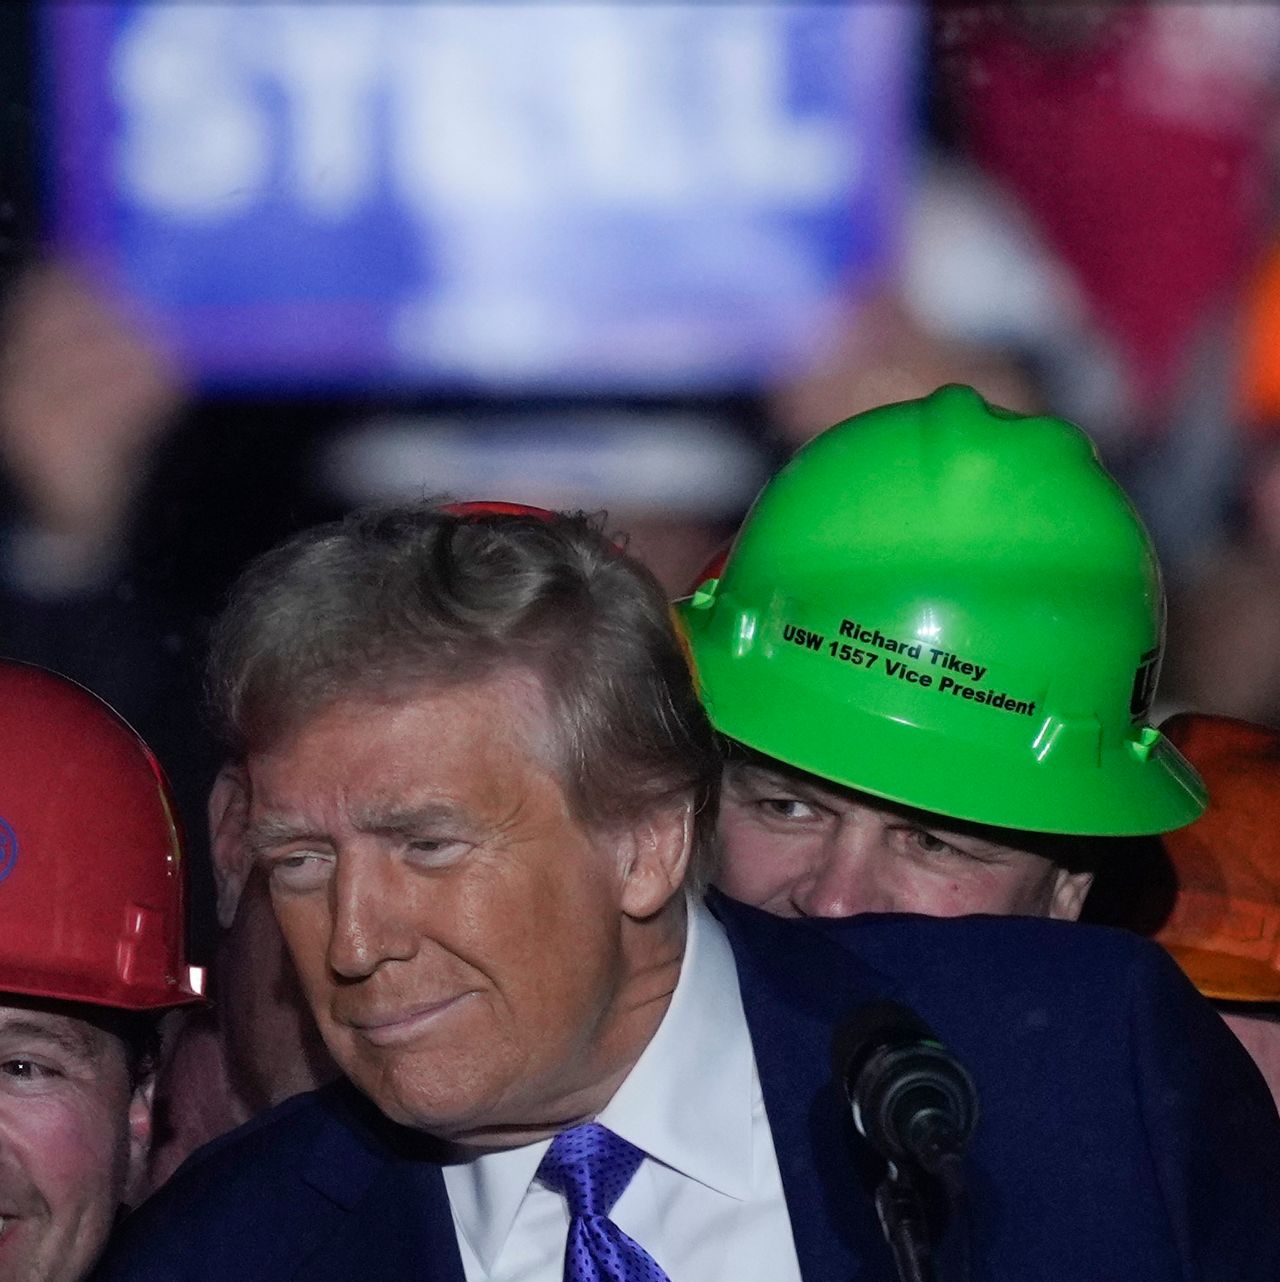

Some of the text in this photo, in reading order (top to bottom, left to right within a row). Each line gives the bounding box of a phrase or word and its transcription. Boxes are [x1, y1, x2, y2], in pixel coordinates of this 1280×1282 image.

[782, 624, 1036, 717] USW 1557 Vice President
[838, 618, 987, 682] Richard Tikey
